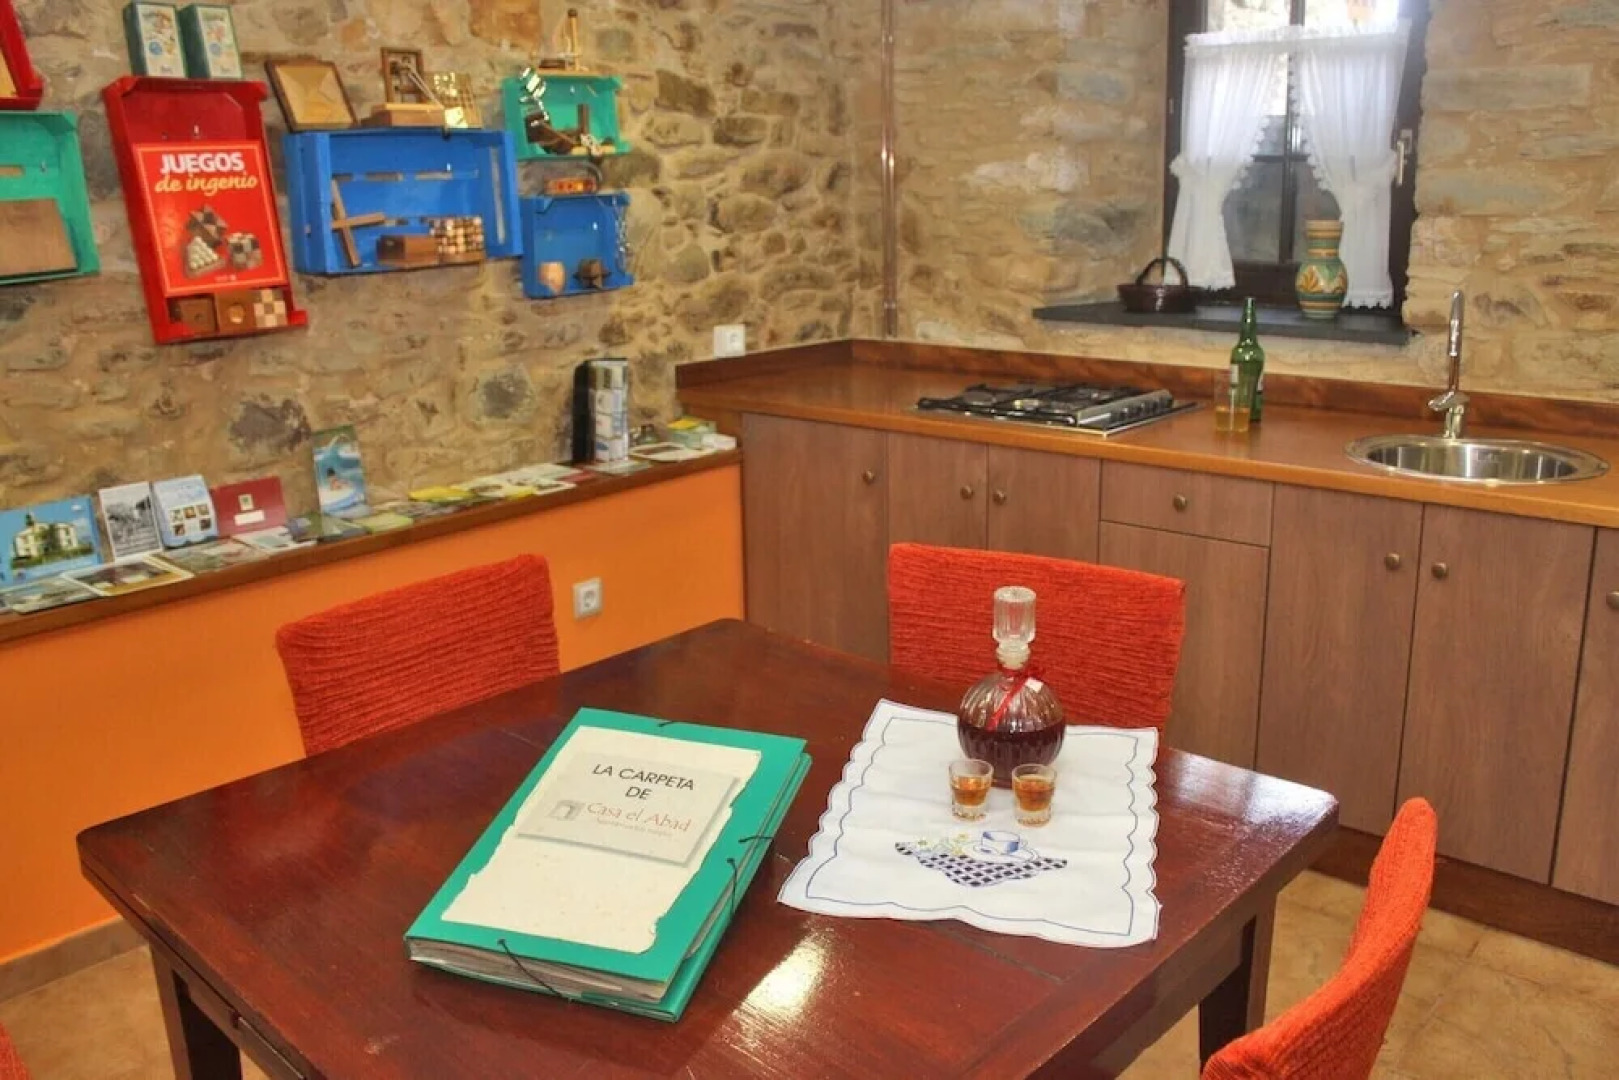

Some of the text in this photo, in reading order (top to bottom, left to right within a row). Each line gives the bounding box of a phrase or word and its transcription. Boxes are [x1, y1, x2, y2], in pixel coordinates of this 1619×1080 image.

[160, 152, 245, 174] JUEGOS
[155, 171, 258, 196] de ingenio
[592, 763, 695, 791] LA CARPETA
[625, 786, 652, 800] DE
[587, 802, 622, 819] Casa
[626, 807, 644, 821] el
[648, 813, 692, 832] Abad
